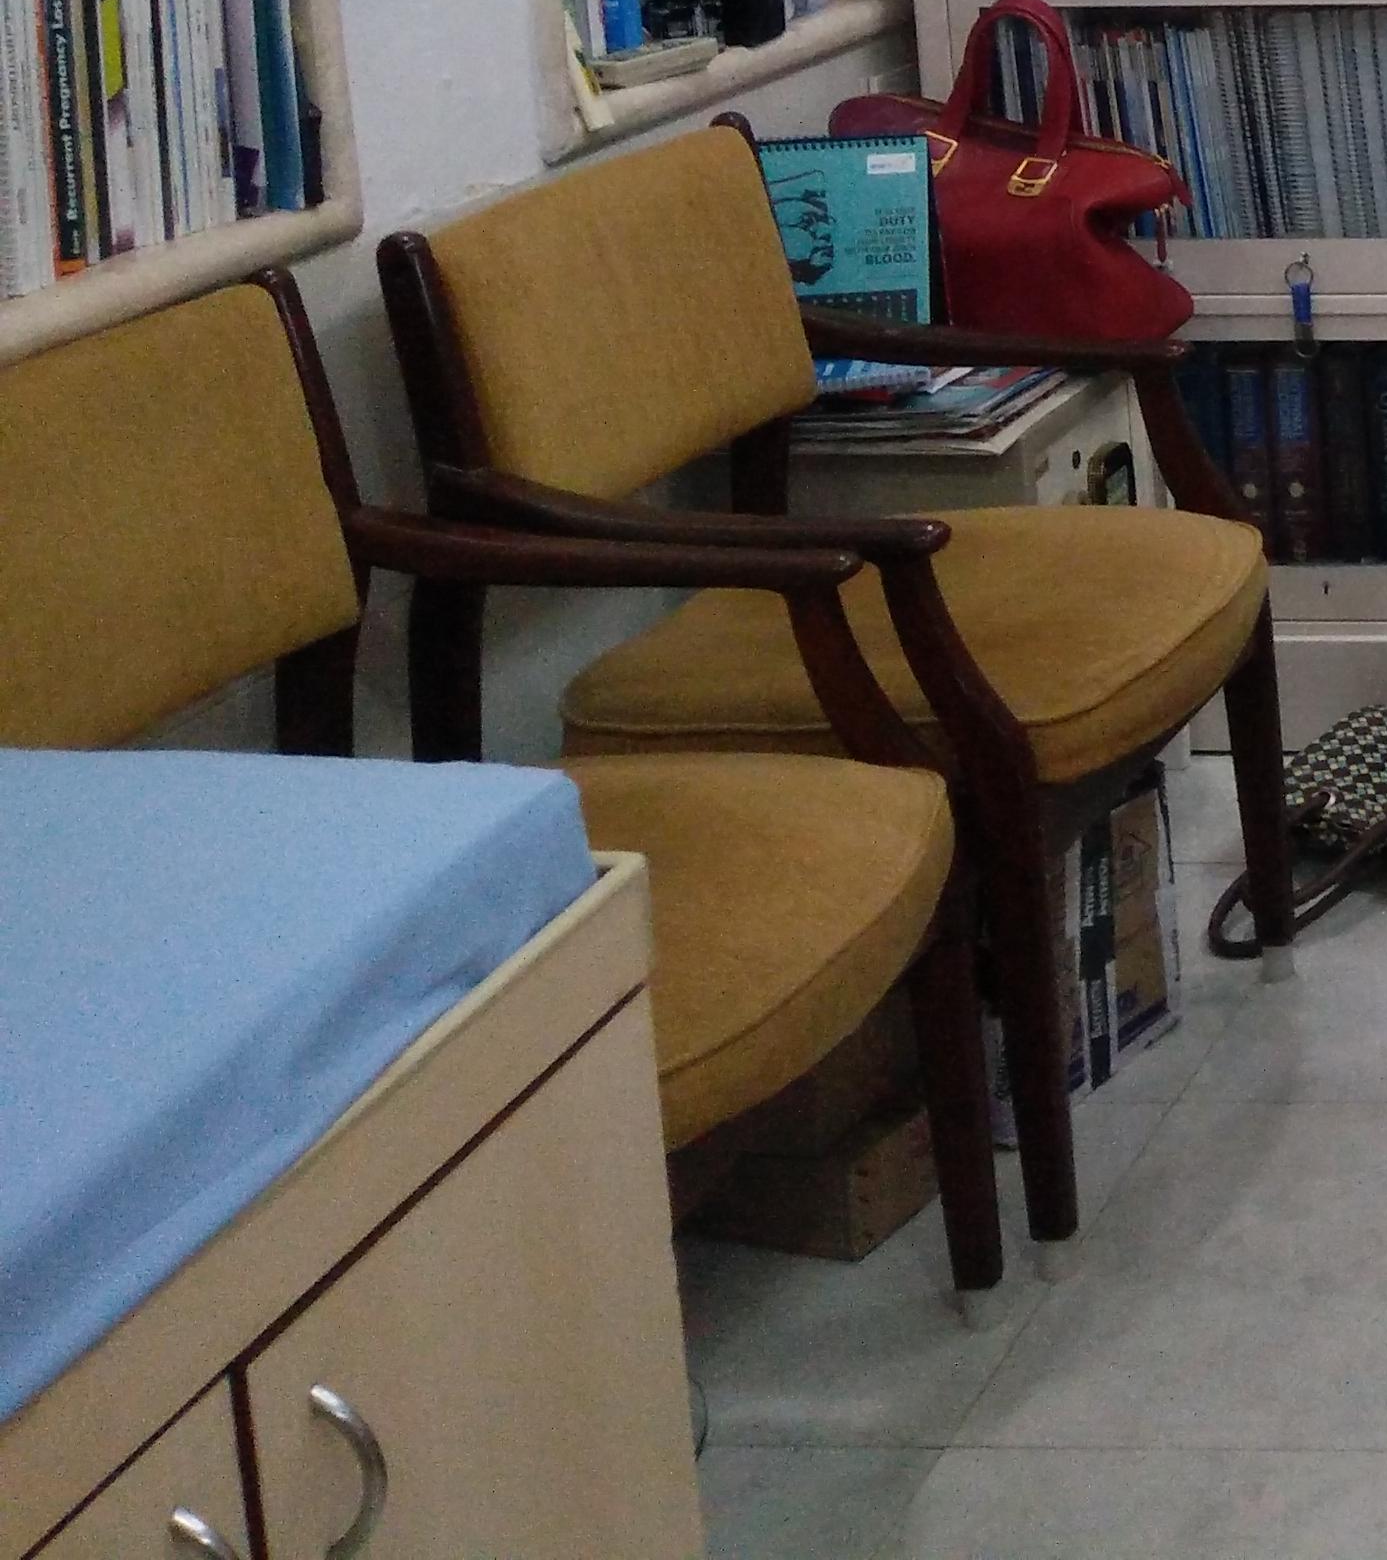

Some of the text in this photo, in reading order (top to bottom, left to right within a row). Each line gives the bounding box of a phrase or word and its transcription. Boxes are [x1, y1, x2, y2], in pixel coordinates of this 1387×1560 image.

[54, 33, 73, 131] Pregnancy
[62, 132, 79, 222] Recurrent
[879, 215, 916, 227] DUTY
